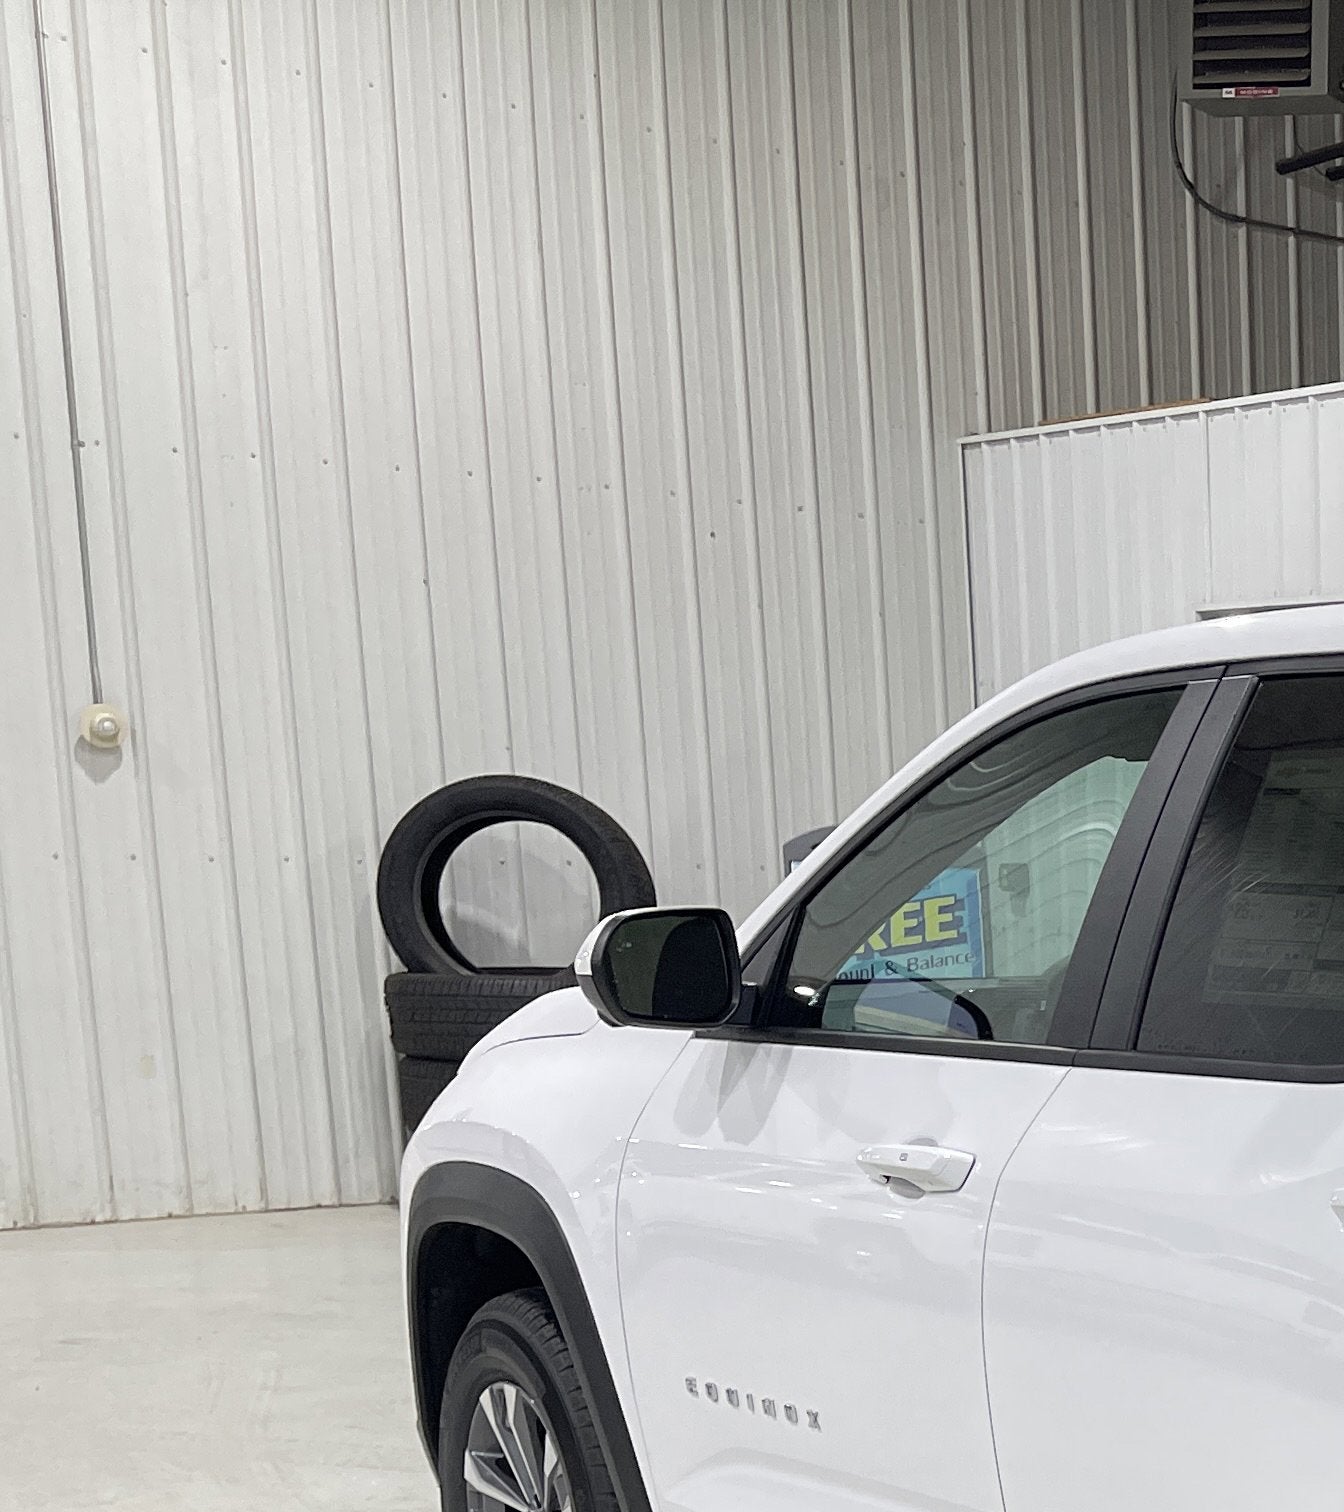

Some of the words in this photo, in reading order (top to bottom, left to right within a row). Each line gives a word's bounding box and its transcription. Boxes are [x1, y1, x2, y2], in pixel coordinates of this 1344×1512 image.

[853, 896, 958, 954] REE
[885, 960, 898, 976] &
[907, 951, 975, 972] Balance
[685, 1376, 823, 1433] EQUINOX
